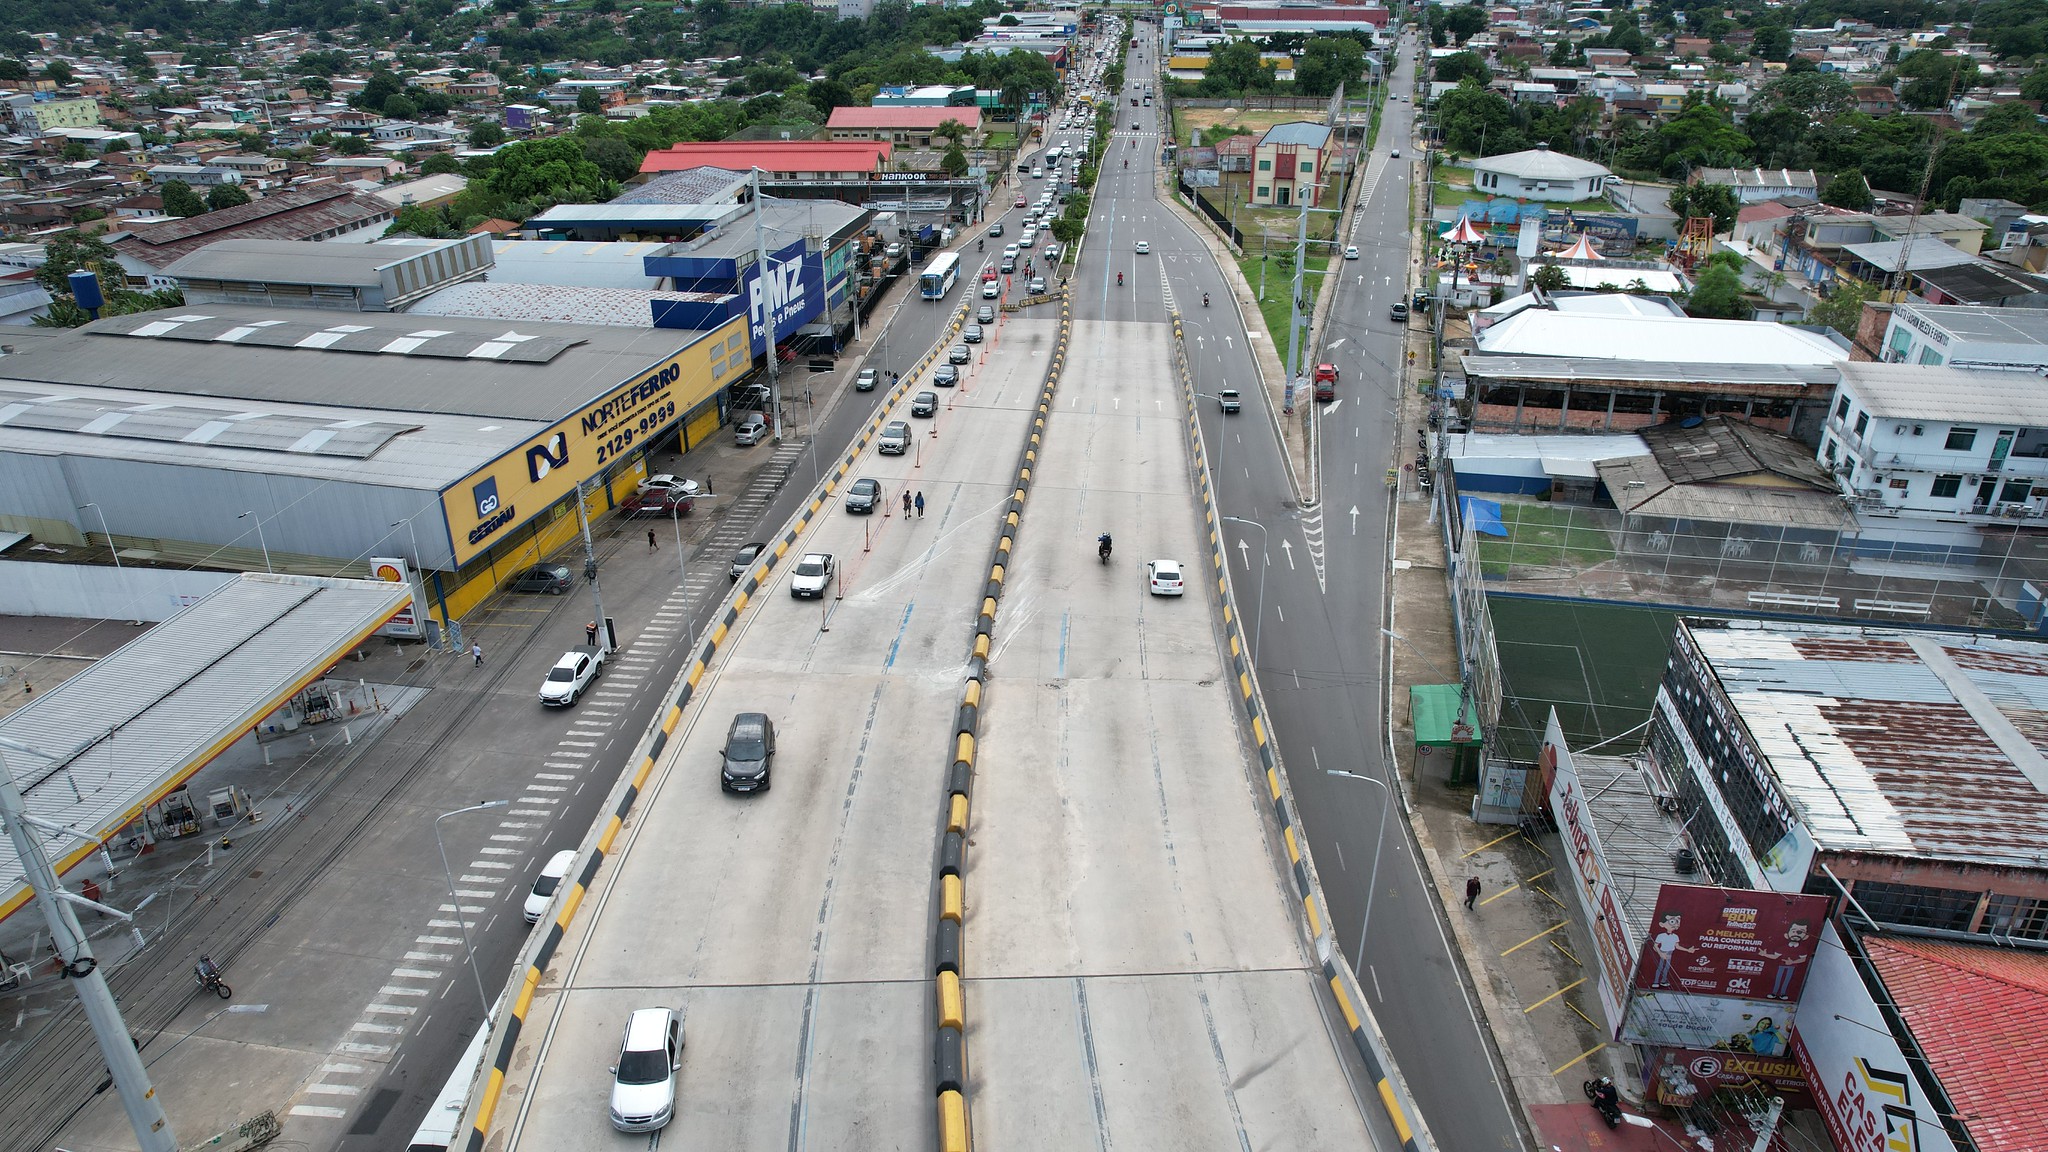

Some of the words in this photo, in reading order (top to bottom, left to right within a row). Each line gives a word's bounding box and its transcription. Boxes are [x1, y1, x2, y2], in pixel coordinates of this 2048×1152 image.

[749, 254, 805, 325] PMZ
[778, 313, 783, 323] e
[784, 299, 806, 320] Pneus
[581, 362, 681, 437] NORTEFERRO
[596, 401, 676, 465] 2129-9999
[468, 503, 516, 545] GERDAU
[1699, 935, 1719, 943] PARA
[1720, 937, 1763, 946] CONSTRUIR
[1713, 943, 1757, 953] REFORMAR!
[1715, 930, 1755, 939] MELHOR
[1796, 1041, 1811, 1072] TUDO
[1809, 1071, 1820, 1090] EM
[1817, 1087, 1843, 1146] MATERIAL
[1837, 1089, 1871, 1152] ELE
[1845, 1071, 1886, 1152] CASA
